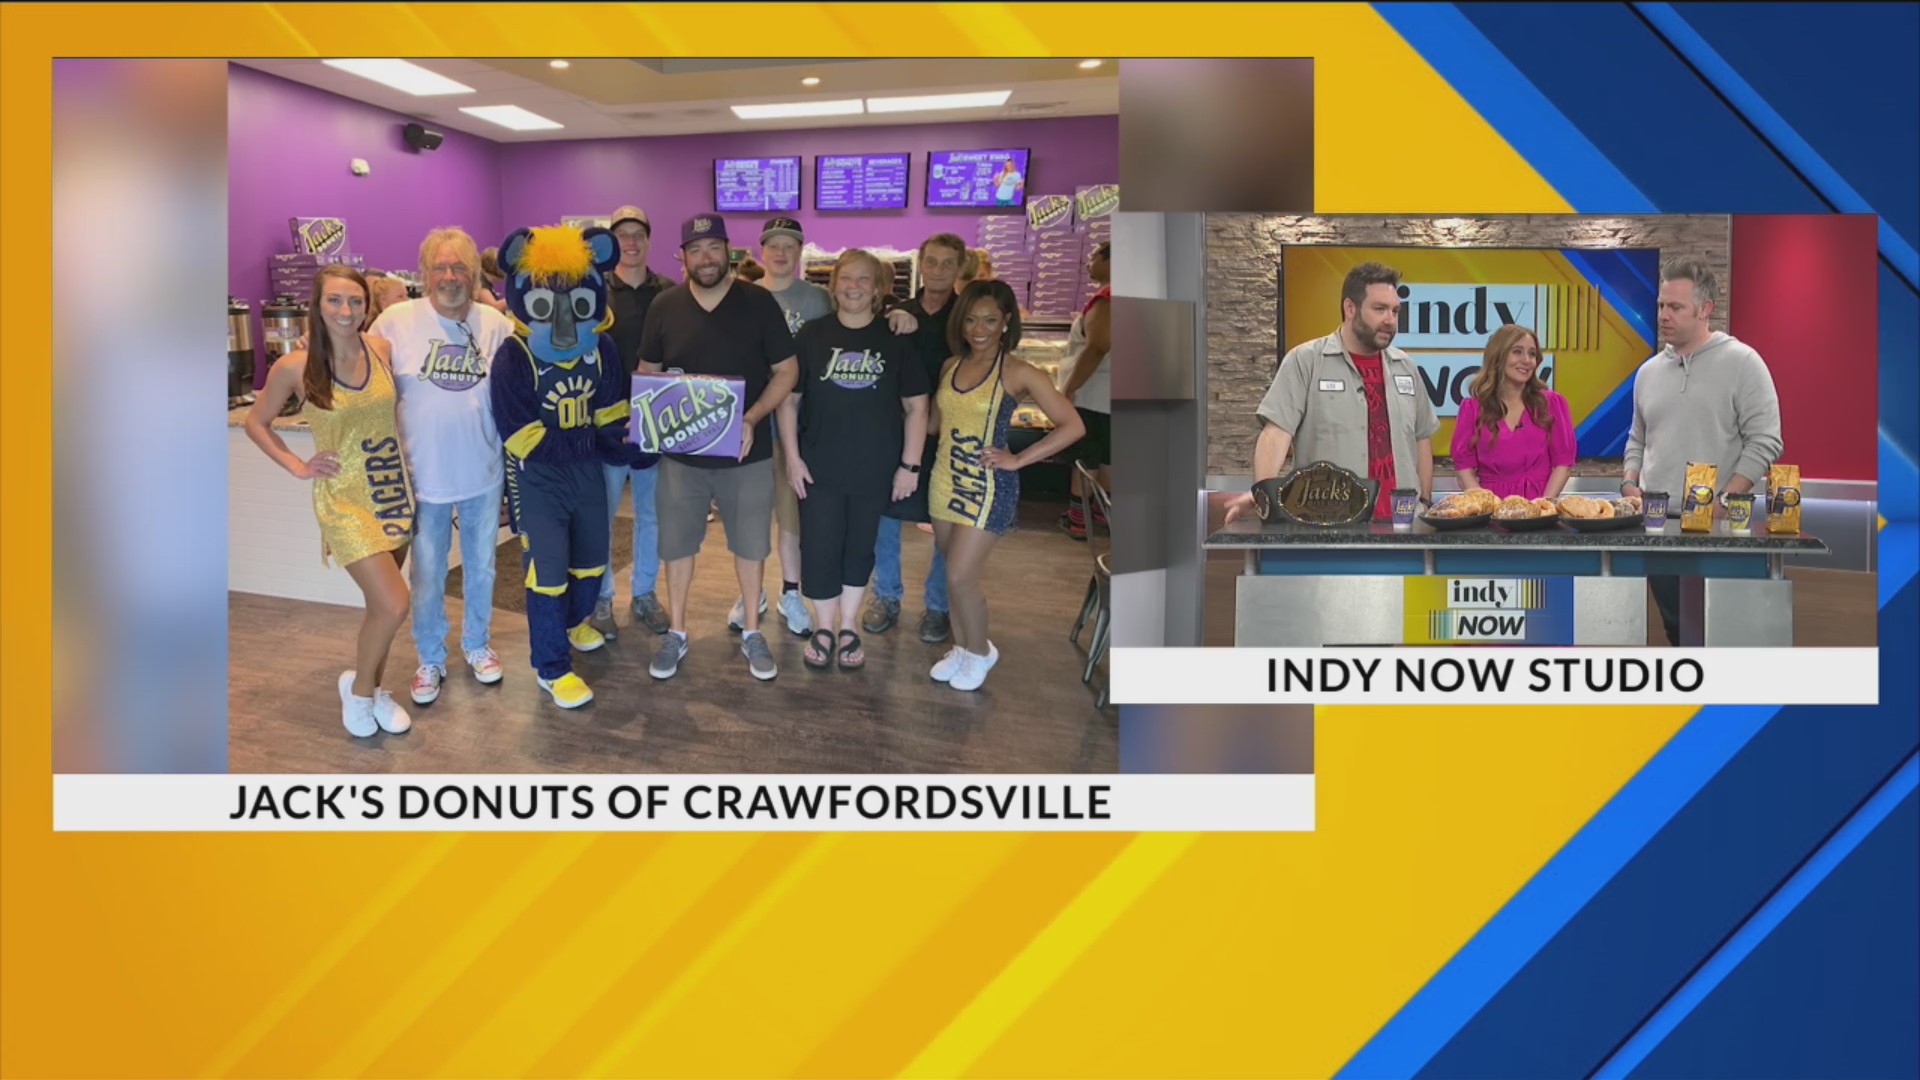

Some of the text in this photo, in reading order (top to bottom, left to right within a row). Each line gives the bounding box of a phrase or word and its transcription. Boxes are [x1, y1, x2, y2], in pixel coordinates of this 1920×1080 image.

[417, 338, 487, 381] Jacks
[820, 347, 886, 381] Jack's
[432, 371, 479, 384] DONUTS
[833, 372, 878, 382] DONUTS
[631, 378, 729, 454] Jacks
[662, 406, 729, 449] DONUTS
[361, 436, 414, 537] PACERS
[947, 427, 986, 522] PACERS
[1298, 479, 1351, 507] Jack's
[1453, 579, 1514, 609] indy
[1458, 615, 1525, 636] NOW
